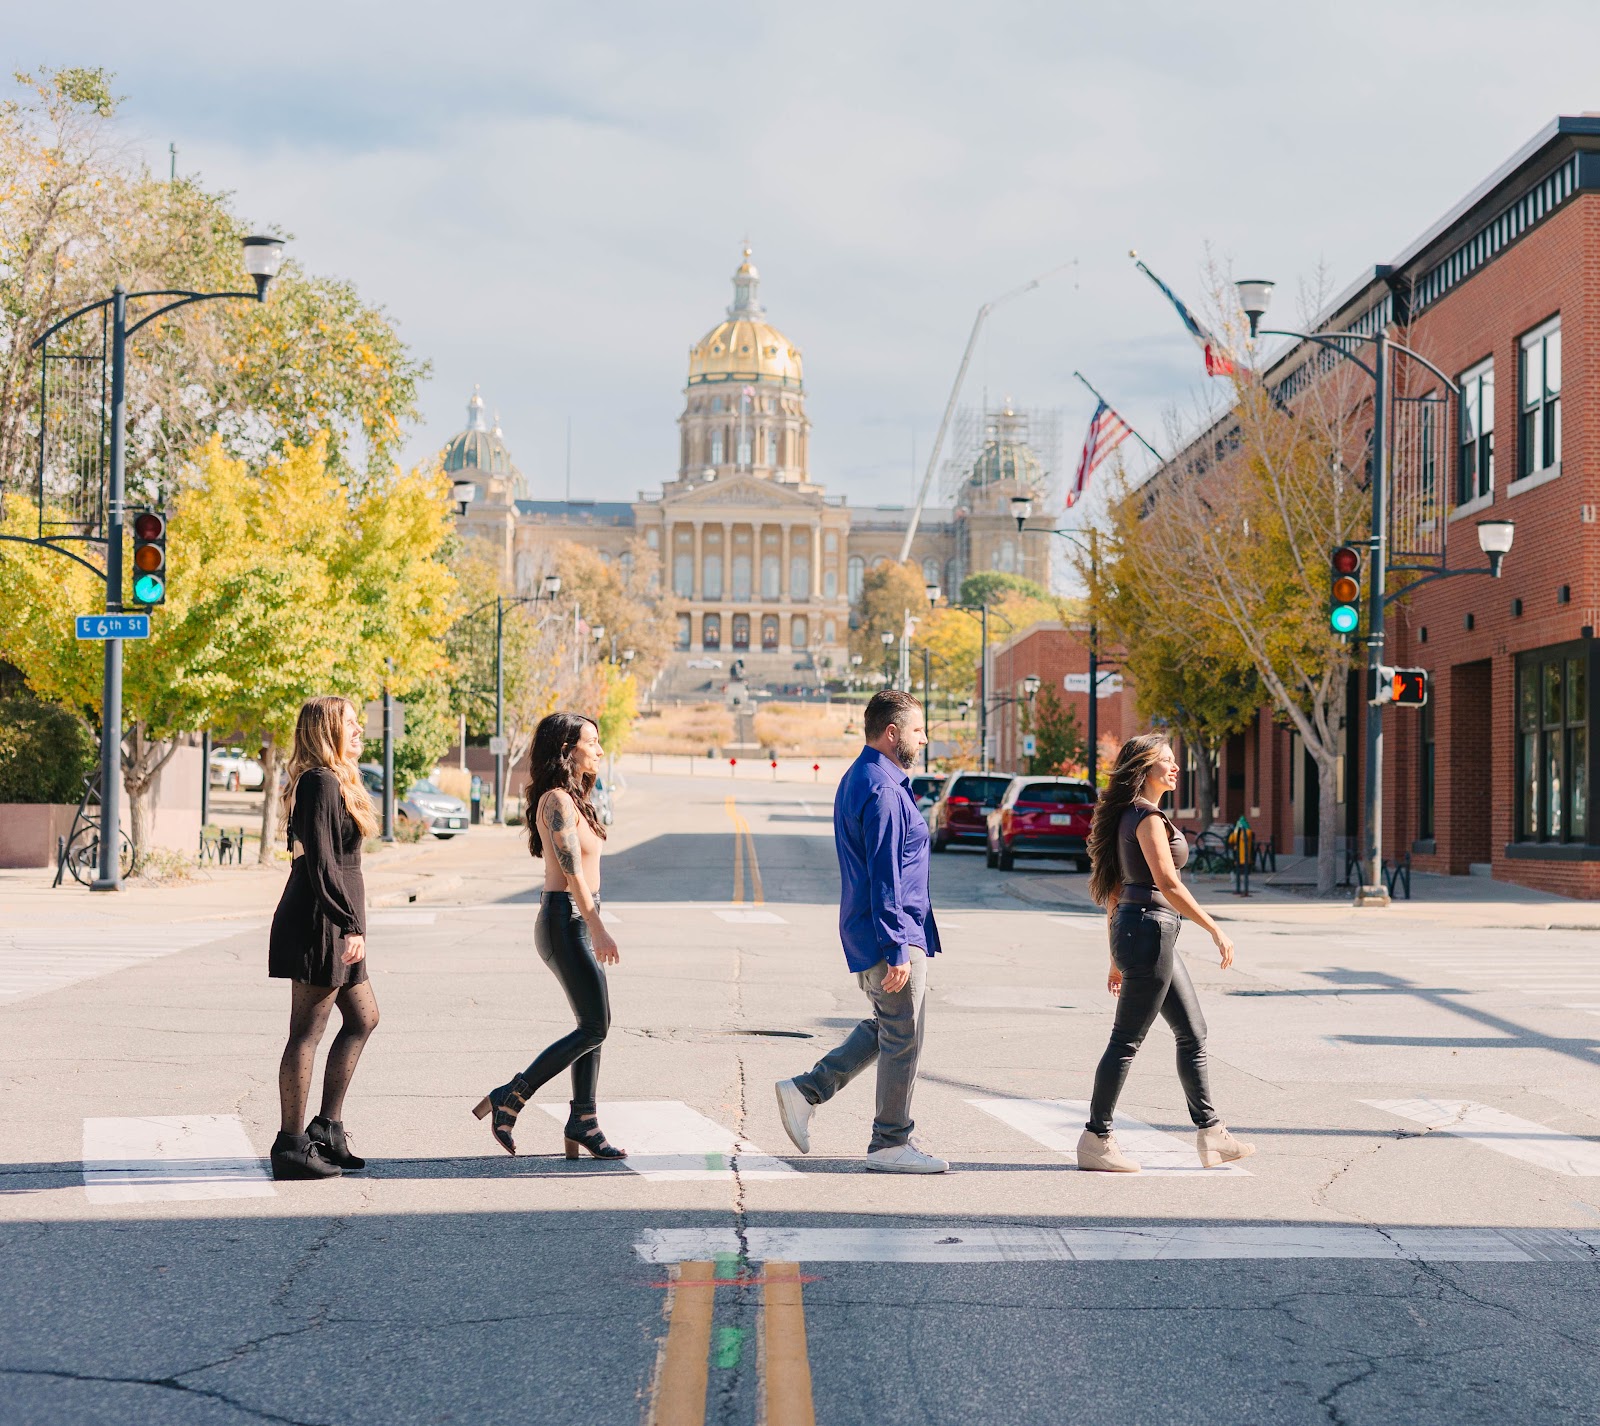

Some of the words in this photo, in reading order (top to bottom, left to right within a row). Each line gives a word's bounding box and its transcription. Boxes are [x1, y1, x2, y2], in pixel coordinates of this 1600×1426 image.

[83, 619, 91, 632] E
[97, 620, 121, 636] 6th
[128, 619, 142, 630] St
